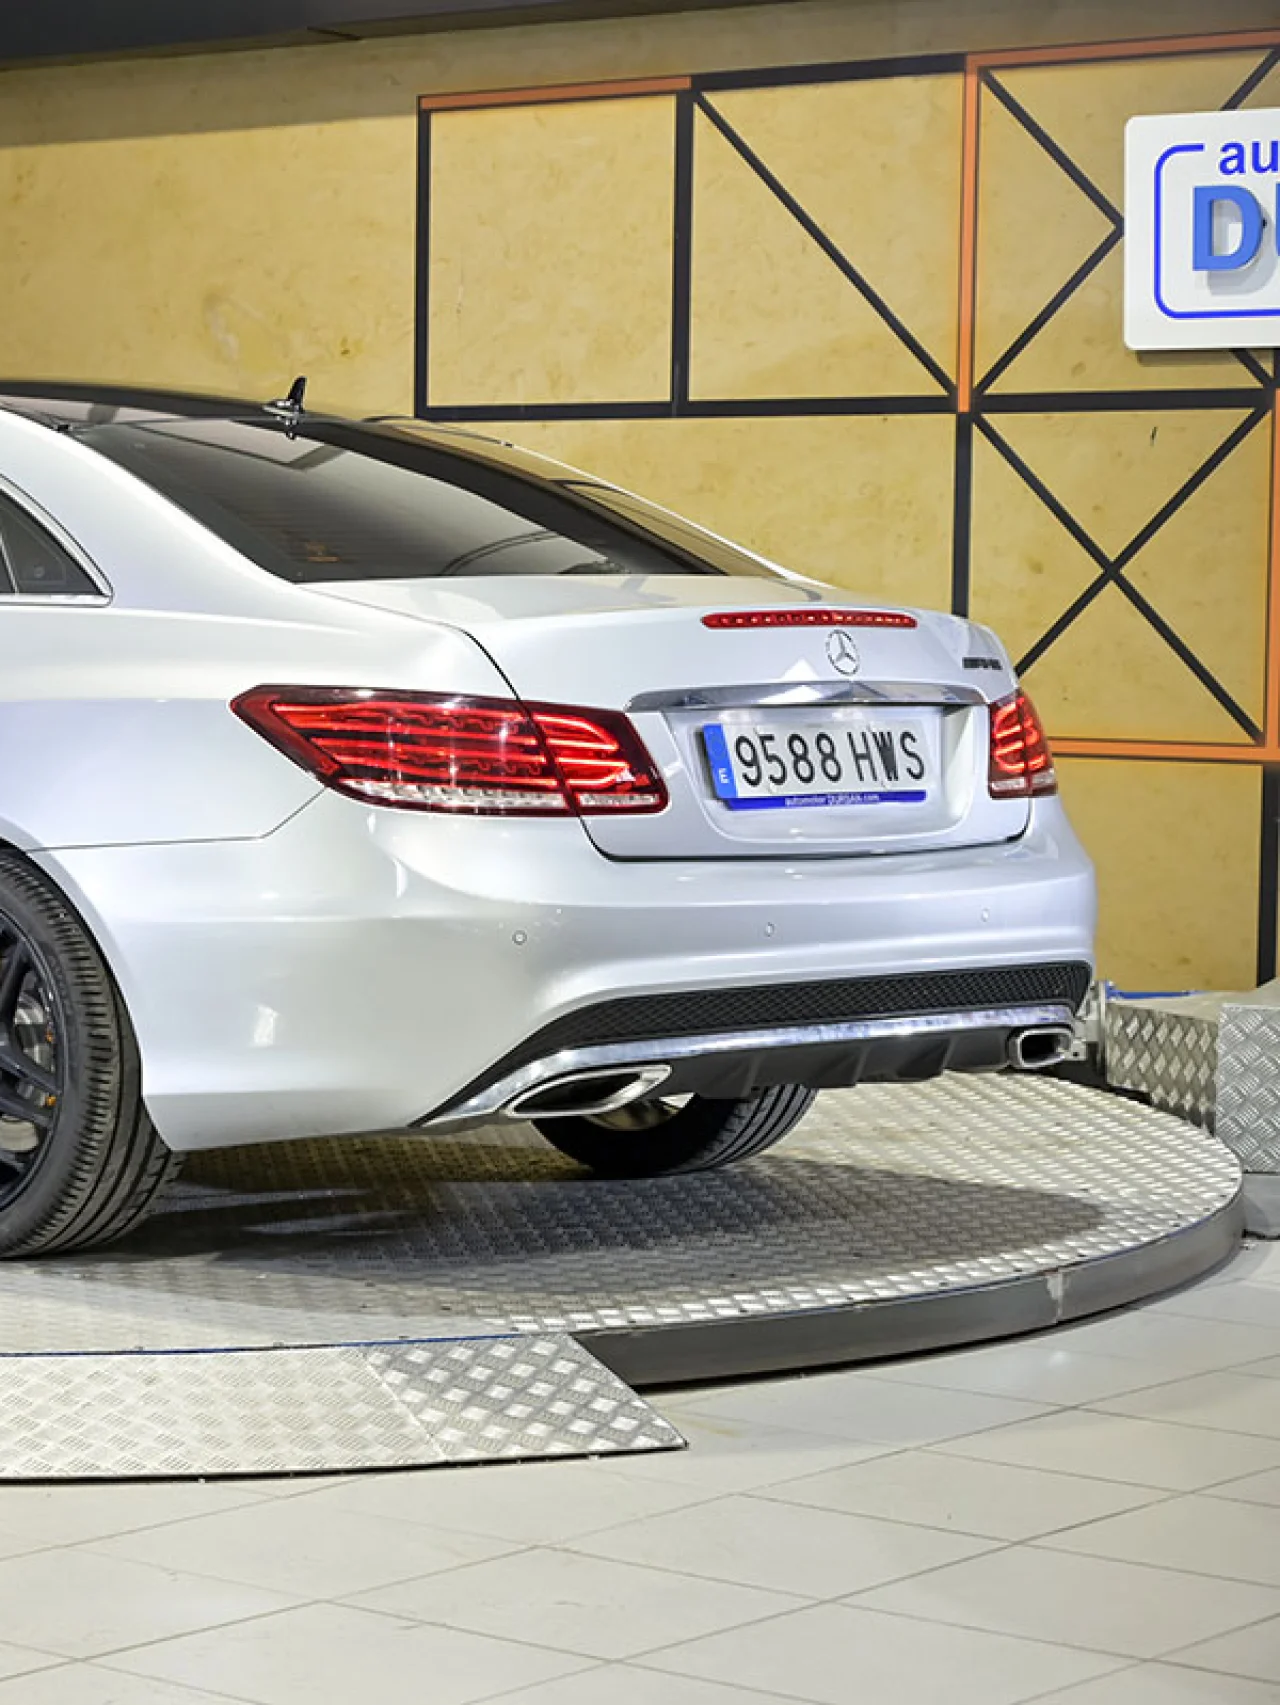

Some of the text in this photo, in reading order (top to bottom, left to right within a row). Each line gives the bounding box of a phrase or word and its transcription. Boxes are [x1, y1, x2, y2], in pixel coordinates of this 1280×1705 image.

[1218, 140, 1280, 176] au
[1191, 181, 1280, 272] D
[718, 767, 730, 785] E
[734, 730, 925, 787] 9588 HWS
